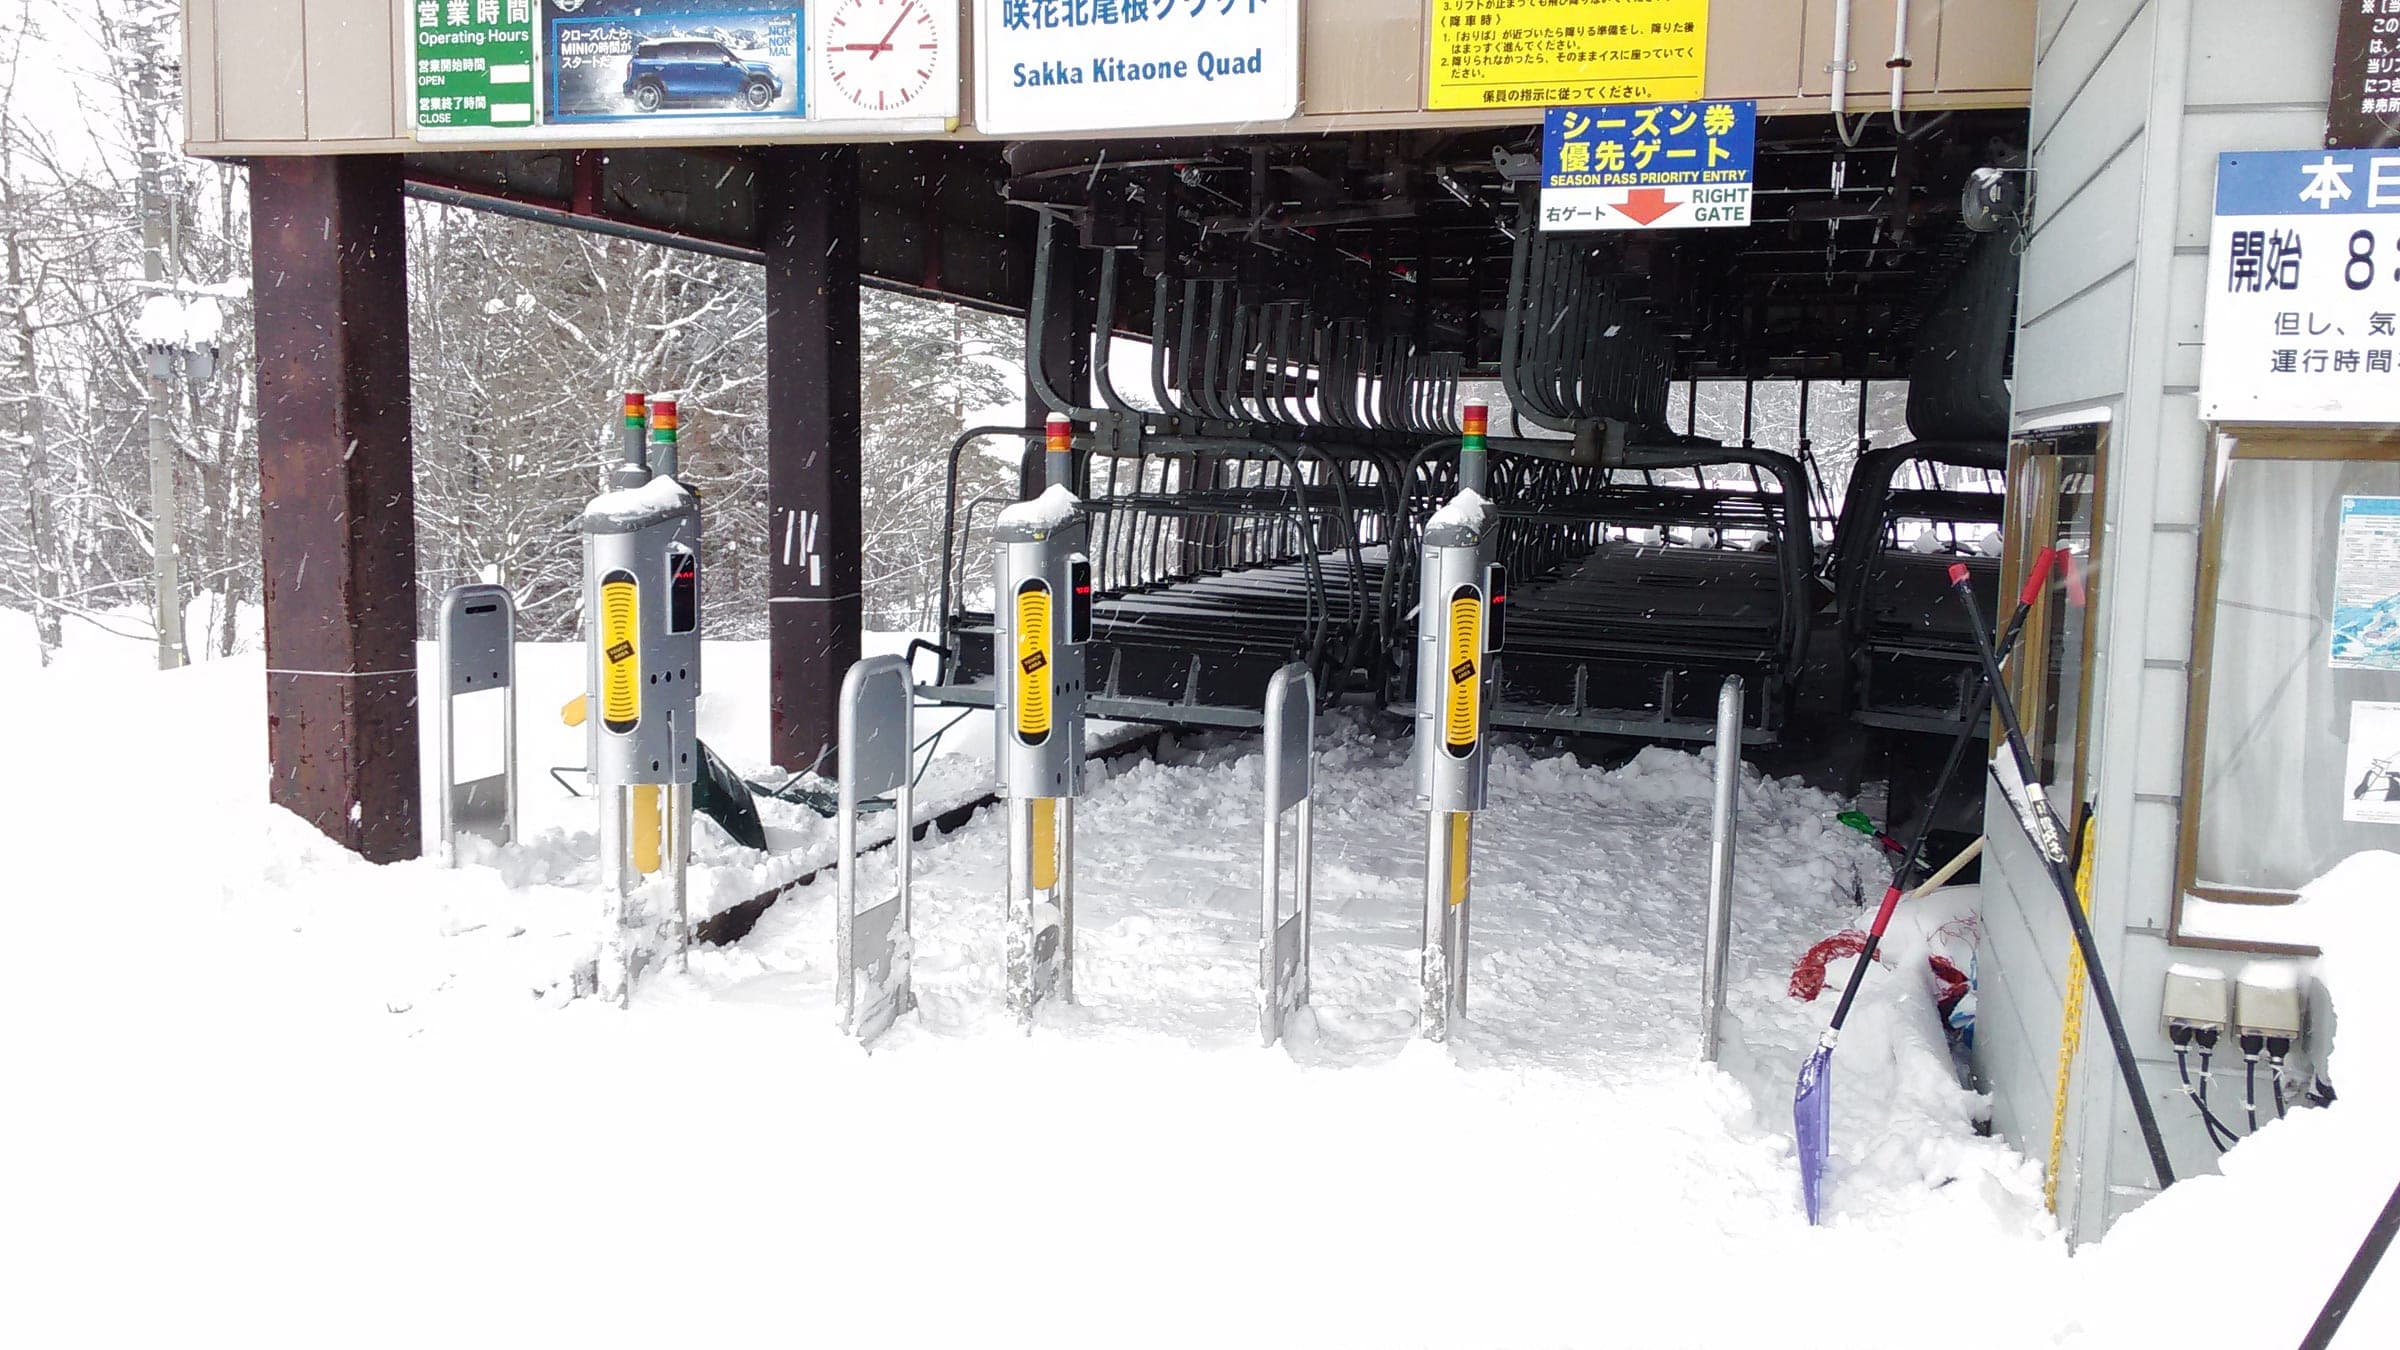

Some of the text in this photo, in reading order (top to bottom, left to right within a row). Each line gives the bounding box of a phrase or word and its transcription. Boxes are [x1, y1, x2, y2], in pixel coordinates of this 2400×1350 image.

[418, 0, 529, 27] 営業時間
[419, 29, 529, 47] Operating Hours
[418, 58, 486, 73] 営業開始時間
[1013, 48, 1262, 88] Sakka Kitaone Quad
[418, 76, 445, 86] OPEN
[419, 96, 487, 111] 営業終了時間
[419, 113, 452, 124] CLOSE
[1562, 103, 1735, 140] シーズン券
[1559, 138, 1730, 172] 優先ゲート
[1550, 170, 1747, 186] SEASON PASS PRIORITY ENTRY
[1692, 188, 1749, 204] RIGHT
[1546, 206, 1606, 222] 右ゲート
[1694, 206, 1745, 222] GATE
[2228, 228, 2302, 293] 開始
[2270, 348, 2400, 373] 運行時間
